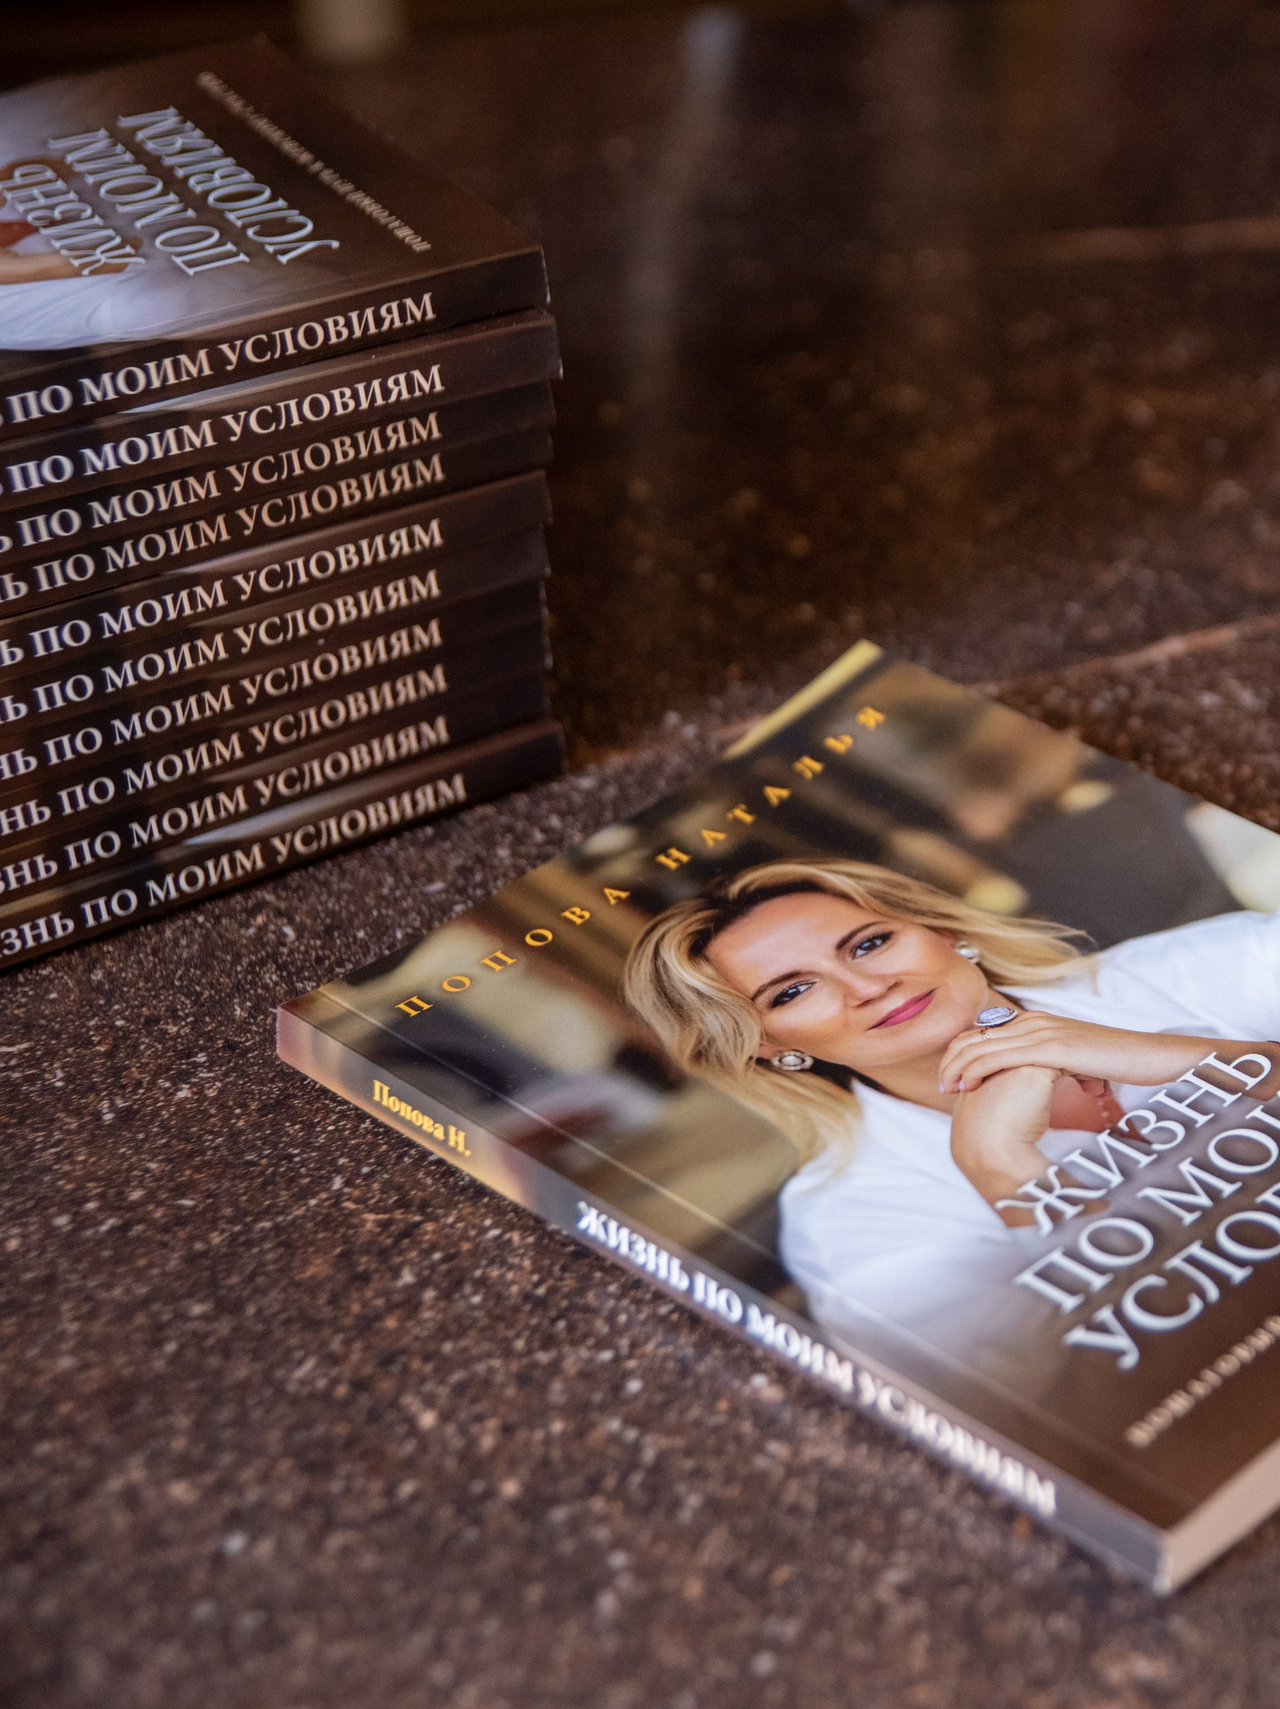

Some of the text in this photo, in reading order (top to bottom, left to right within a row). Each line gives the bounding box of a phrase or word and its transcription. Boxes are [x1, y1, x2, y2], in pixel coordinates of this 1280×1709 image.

[0, 164, 145, 276] ЖИЗНЬ
[48, 127, 249, 276] ПО МОИМ
[117, 105, 340, 264] УСЛОВИЯМ
[7, 292, 437, 423] ПО МОИМ УСЛОВИЯМ
[7, 364, 445, 493] ПО МОИМ УСЛОВИЯМ
[16, 412, 442, 547] ПО МОИМ УСЛОВИЯМ
[29, 620, 91, 657] ПО
[99, 579, 228, 638] МОИМ
[233, 518, 443, 601] УСЛОВИЯМ
[33, 554, 95, 592] ПО
[101, 514, 231, 573] МОИМ
[236, 453, 445, 535] УСЛОВИЯМ
[33, 674, 94, 712] ПО
[101, 632, 229, 693] МОИМ
[233, 569, 441, 654] УСЛОВИЯМ
[43, 727, 103, 765] ПО
[110, 684, 235, 745] МОИМ
[239, 618, 443, 704] УСЛОВИЯМ
[57, 663, 447, 816] ПО МОИМ УСЛОВИЯМ
[64, 715, 449, 870] ПО МОИМ УСЛОВИЯМ
[81, 889, 138, 928] ПО
[145, 843, 265, 906] МОИМ
[270, 773, 467, 863] УСЛОВИЯМ
[395, 706, 885, 1017] ПОПОВА НАТАЛЬЯ
[372, 1079, 472, 1157] Попова Н.
[995, 1049, 1274, 1237] ЖИЗНЬ
[577, 1201, 690, 1292] ЖИЗНЬ
[692, 1271, 743, 1323] ПО
[1014, 1218, 1154, 1313] ПО
